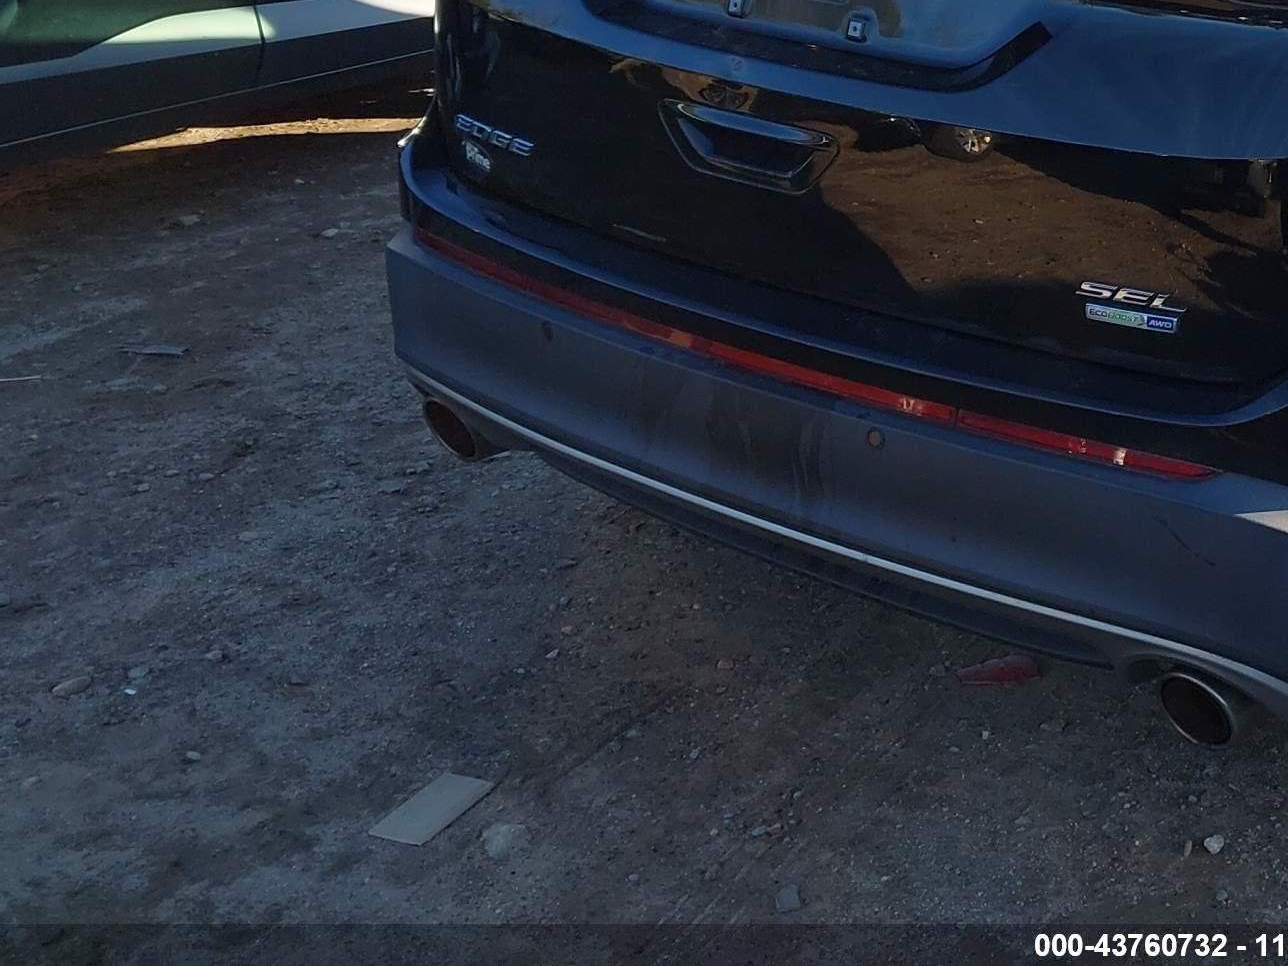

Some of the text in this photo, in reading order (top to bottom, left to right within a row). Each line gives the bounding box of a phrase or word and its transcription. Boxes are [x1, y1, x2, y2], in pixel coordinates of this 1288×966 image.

[455, 114, 535, 157] EDGE
[1075, 281, 1187, 313] SEL
[1148, 318, 1173, 329] AWD
